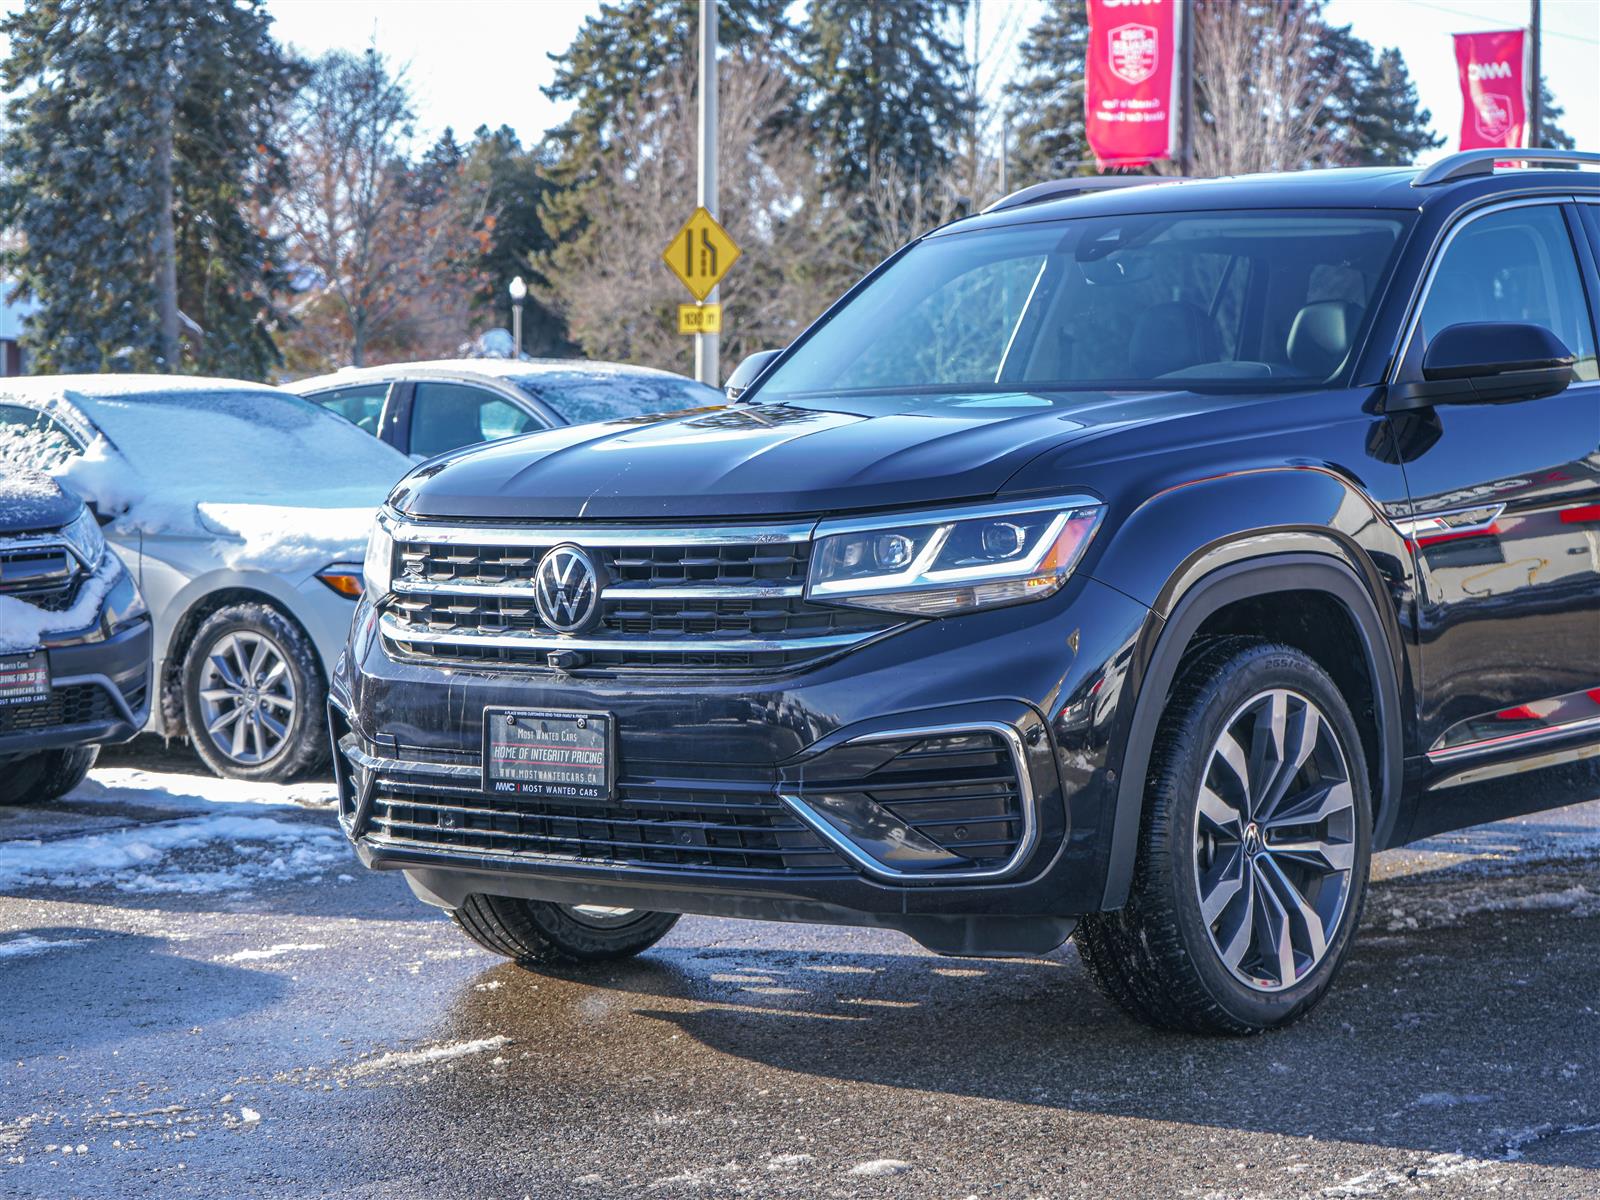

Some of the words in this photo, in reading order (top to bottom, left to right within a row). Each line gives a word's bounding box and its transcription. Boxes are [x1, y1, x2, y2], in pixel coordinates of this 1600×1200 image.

[494, 747, 516, 758] HOME
[519, 747, 529, 760] OF
[531, 748, 571, 761] INTEGRITY
[571, 751, 603, 764] PRICING
[522, 784, 543, 793] MOST
[546, 785, 577, 795] WANTED
[579, 788, 598, 797] CARS
